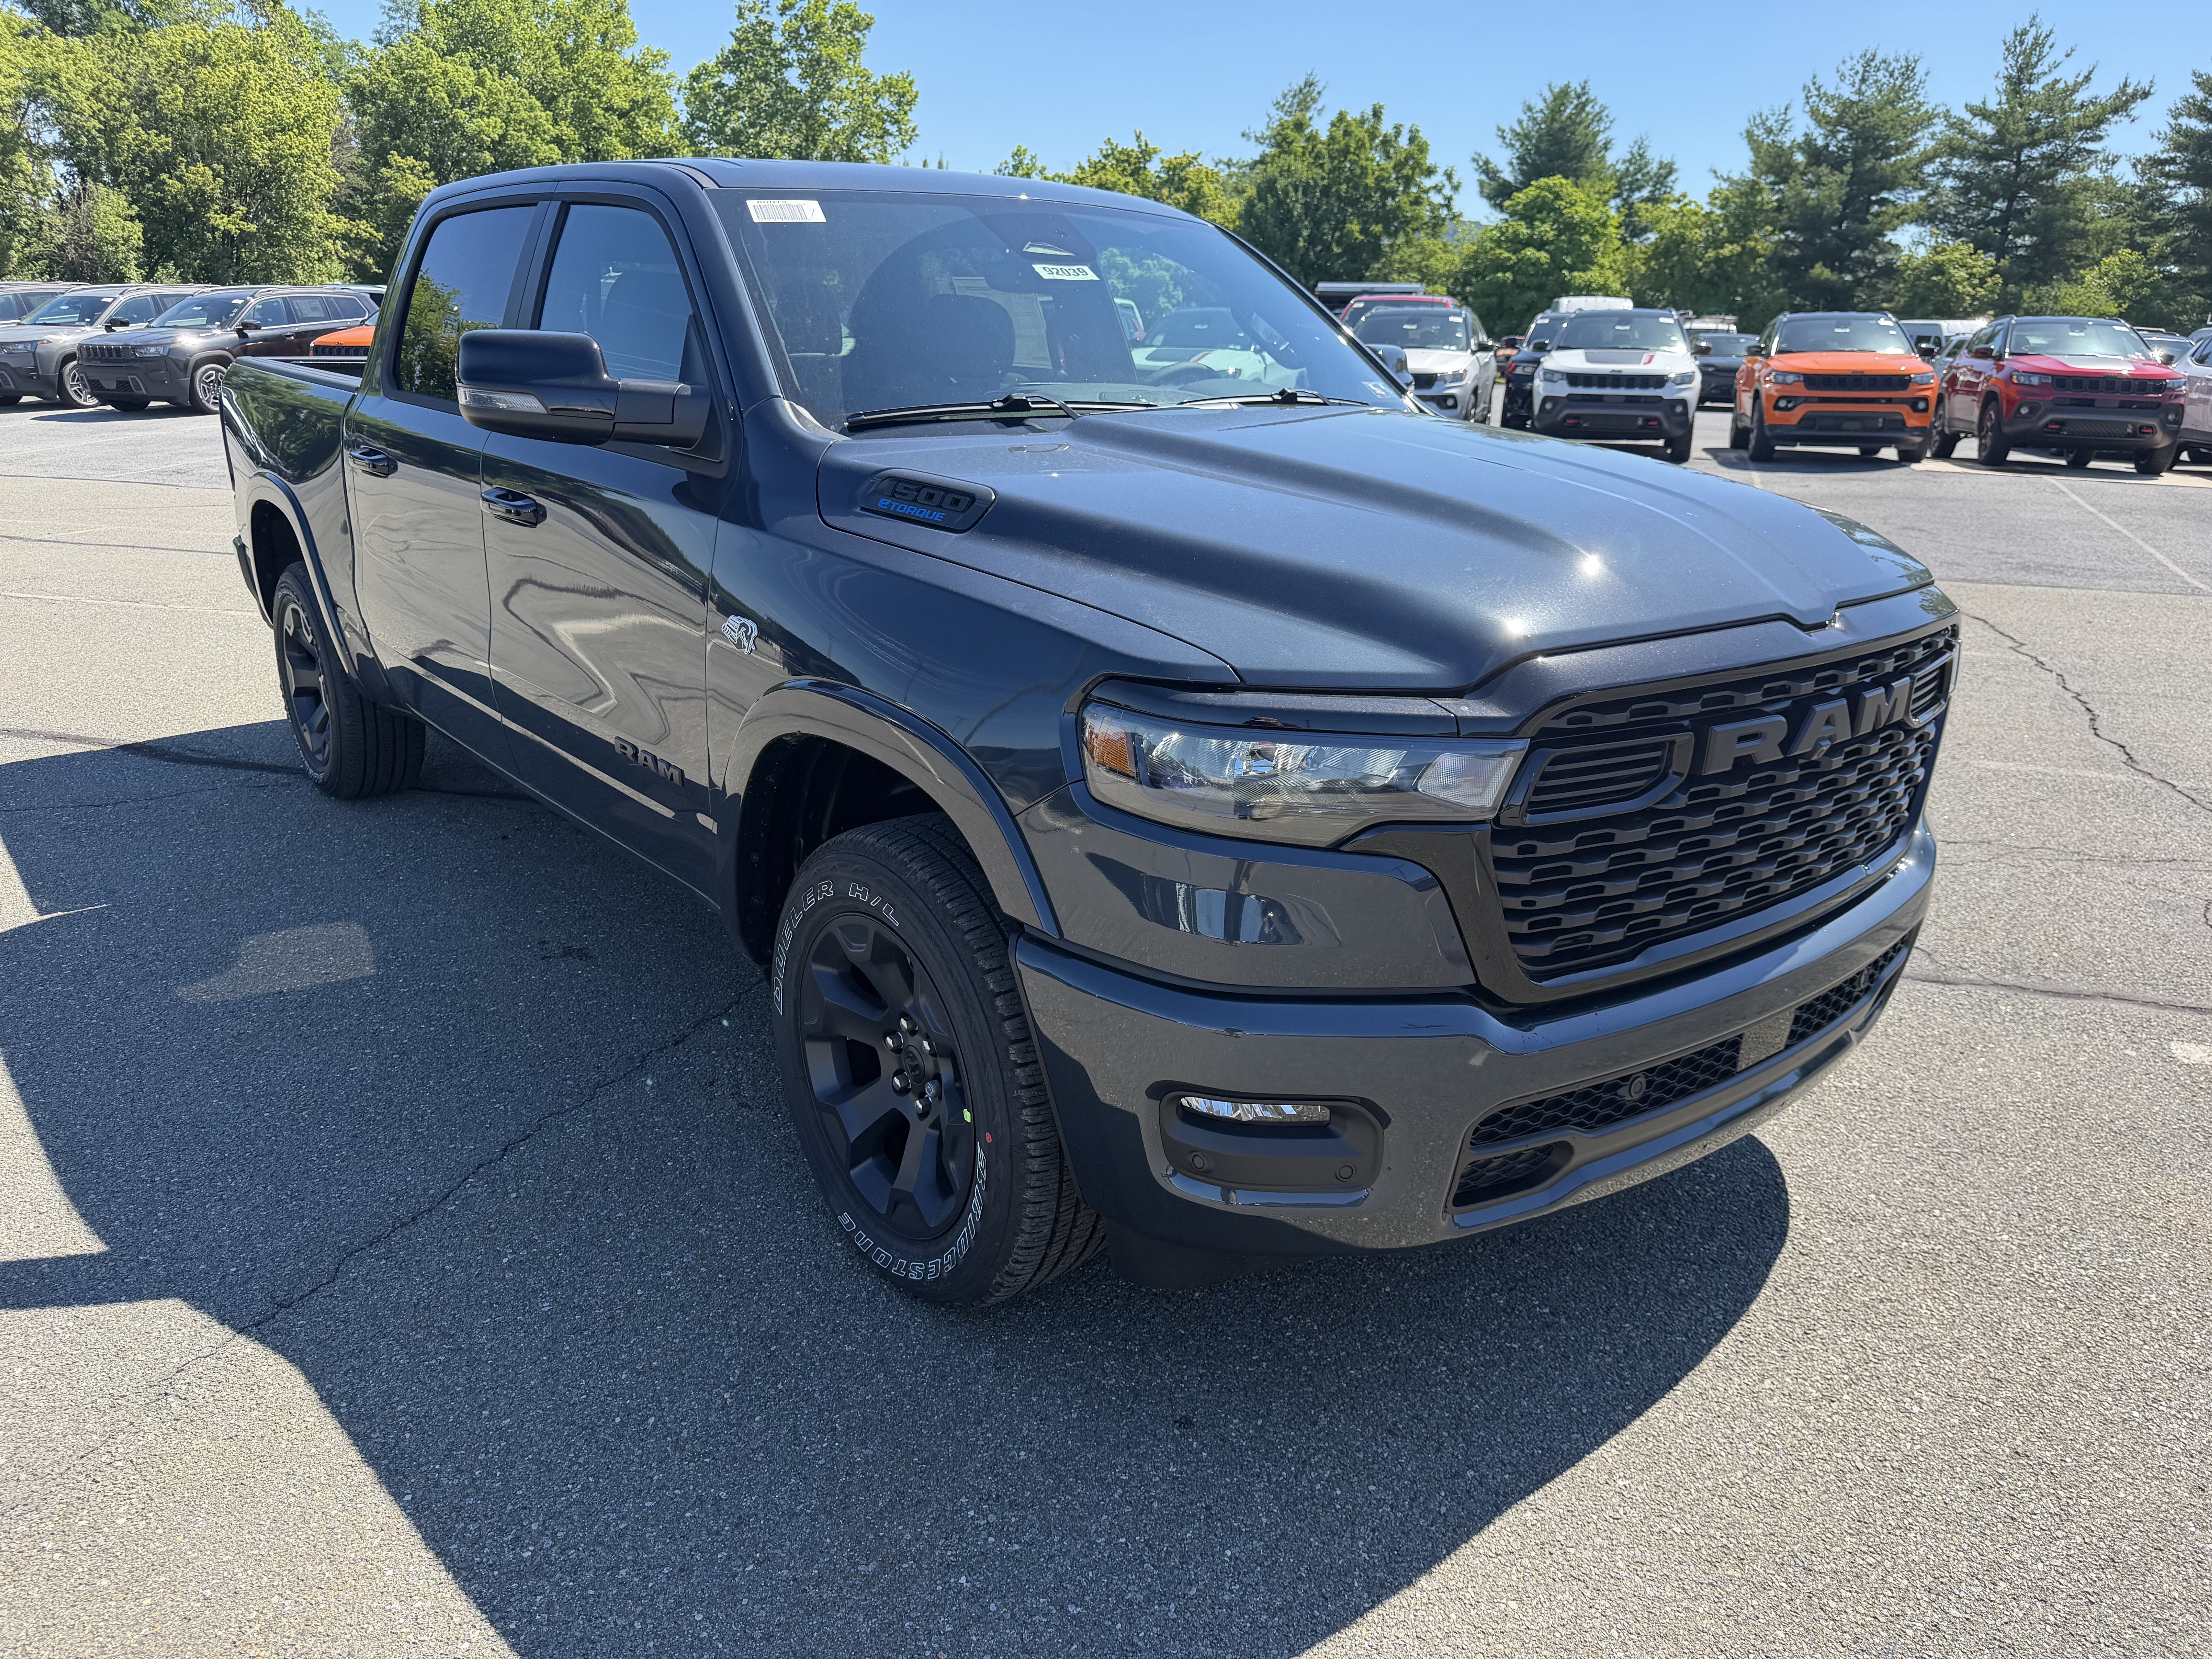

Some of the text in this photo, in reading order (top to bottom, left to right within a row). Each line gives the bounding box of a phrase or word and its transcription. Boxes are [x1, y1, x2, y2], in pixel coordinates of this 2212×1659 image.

[1042, 267, 1089, 276] 92039
[883, 480, 971, 512] 1500
[614, 735, 685, 787] RAM
[1702, 676, 1911, 776] RAM
[773, 880, 899, 1015] DUELER H/L
[837, 1141, 987, 1280] BRIDGESTONE
